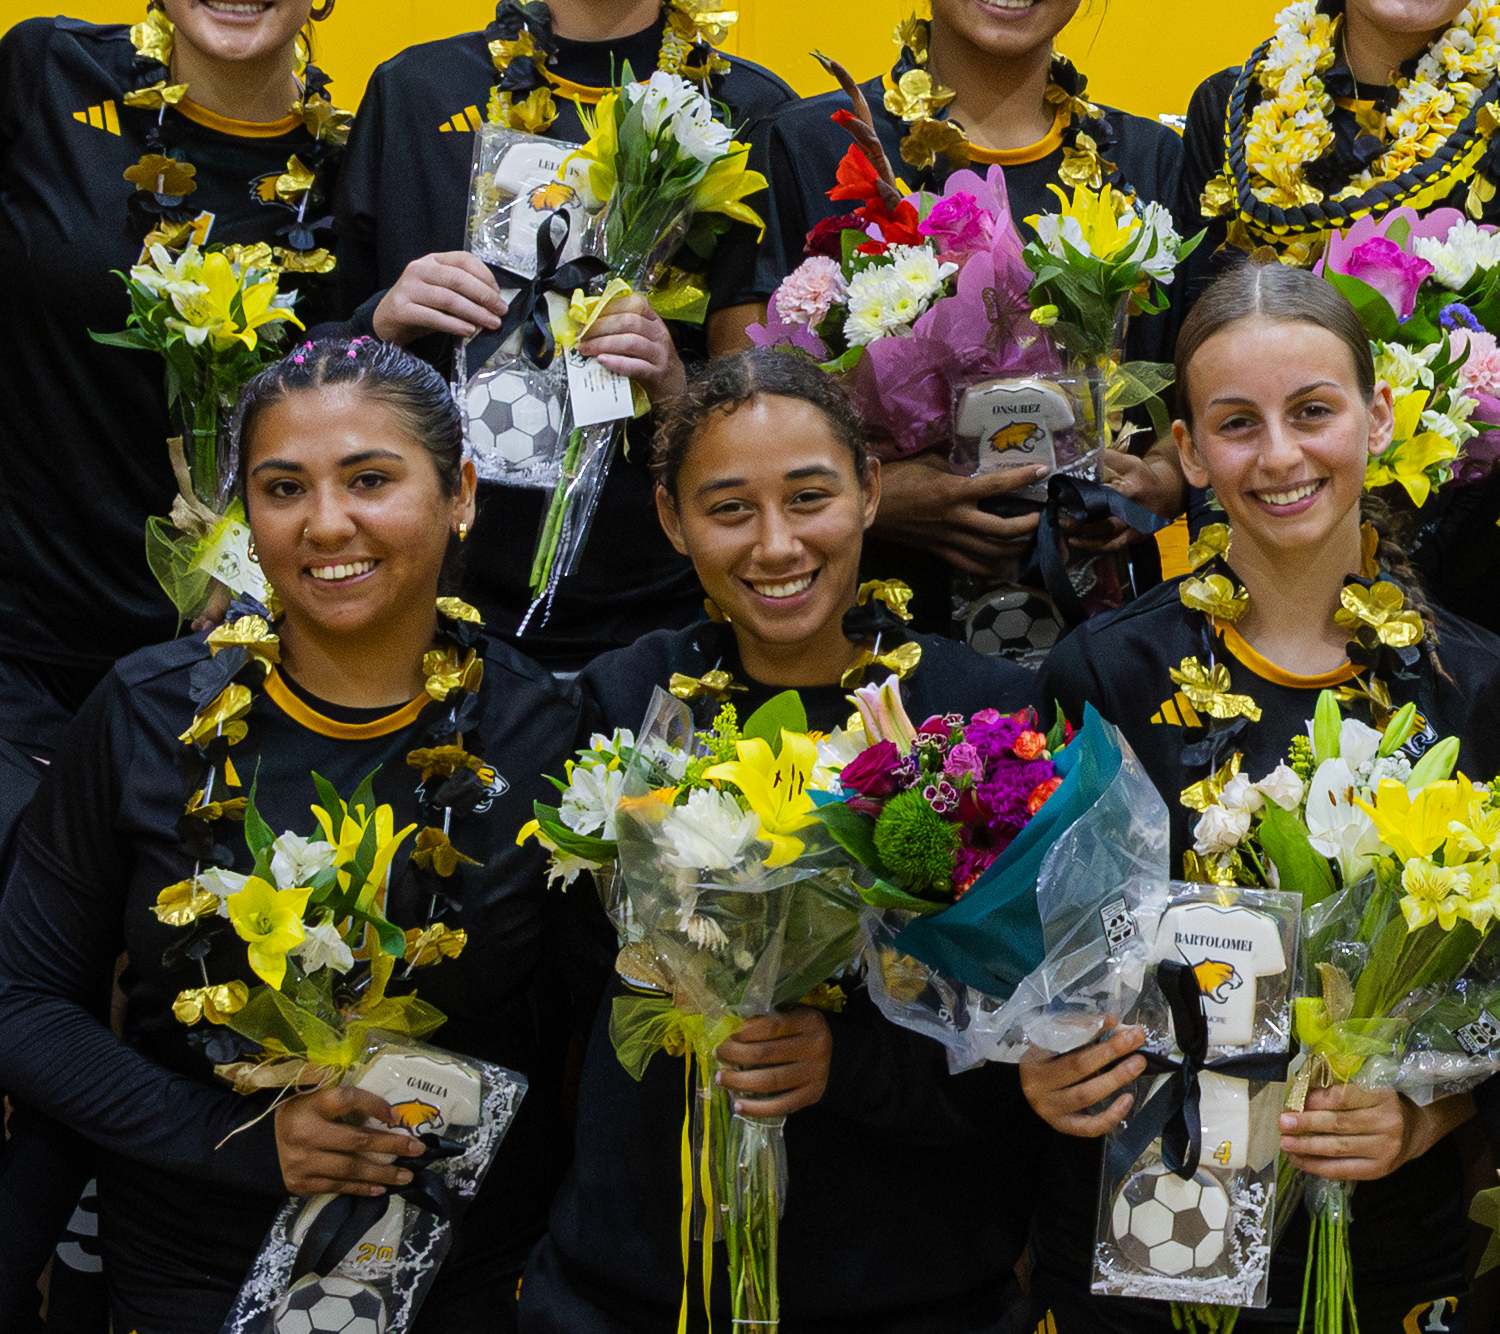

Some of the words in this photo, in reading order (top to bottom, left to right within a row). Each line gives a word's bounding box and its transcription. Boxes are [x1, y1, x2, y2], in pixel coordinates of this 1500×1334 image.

[1174, 931, 1253, 953] BARTOLOMEI
[406, 1076, 449, 1099] GARCIA
[1213, 1140, 1232, 1166] 4
